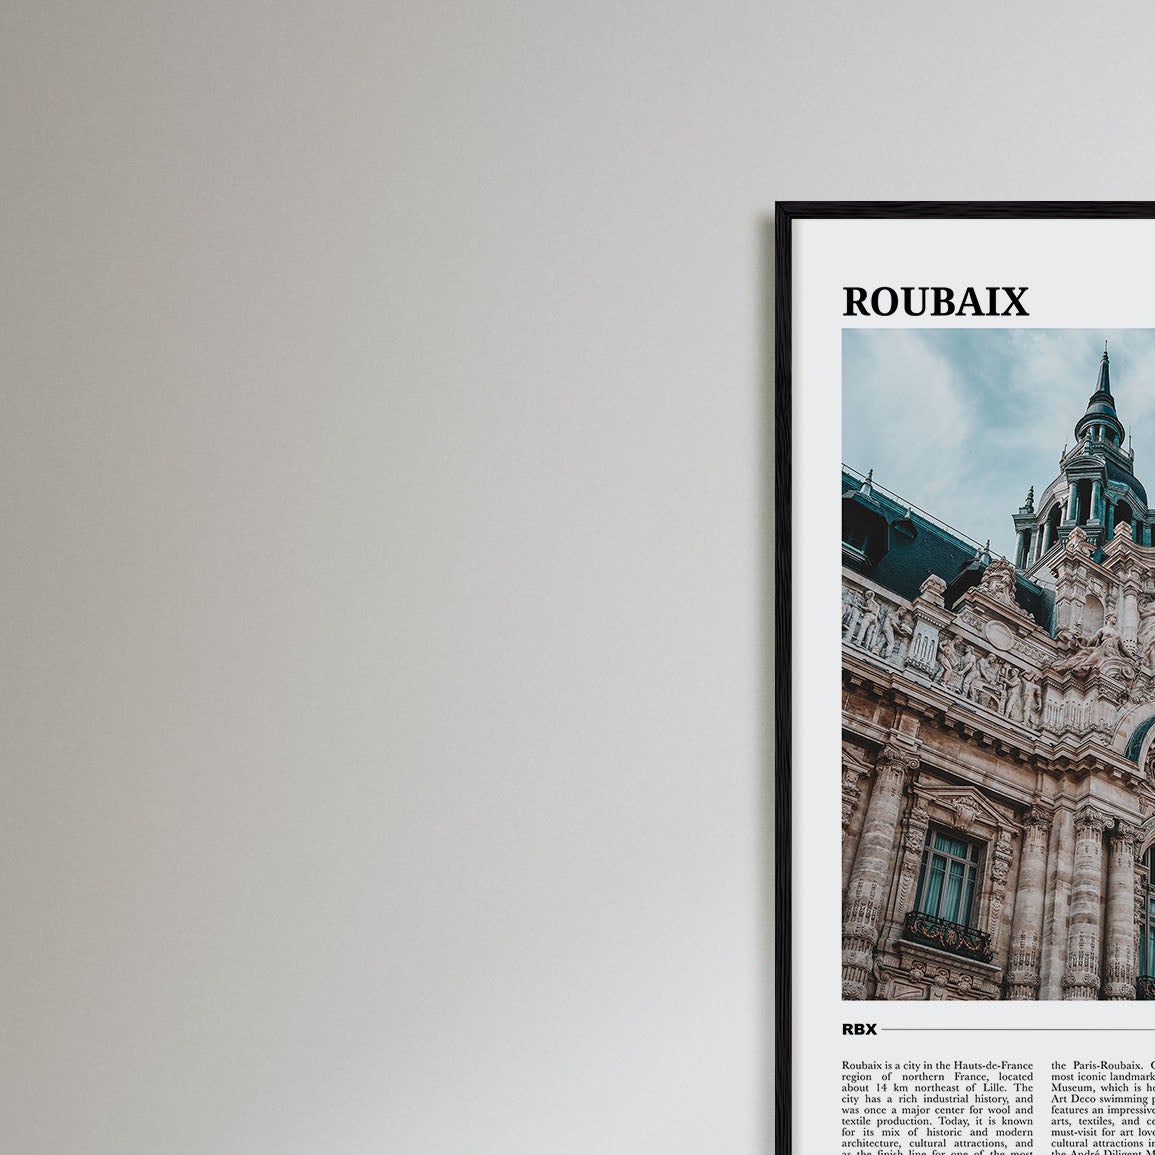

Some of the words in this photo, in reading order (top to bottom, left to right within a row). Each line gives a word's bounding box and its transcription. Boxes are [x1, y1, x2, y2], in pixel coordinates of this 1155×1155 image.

[843, 287, 1030, 316] ROUBAIX
[843, 1023, 877, 1035] RBX
[842, 1061, 882, 1069] Roubaix
[885, 1061, 892, 1069] is
[903, 1061, 920, 1072] city
[923, 1061, 932, 1069] in
[935, 1061, 950, 1069] the
[954, 1061, 1033, 1069] Hauts-de-France
[1051, 1061, 1066, 1069] the
[1073, 1061, 1143, 1069] Paris-Roubaix.
[842, 1072, 871, 1083] region
[881, 1072, 891, 1080] of
[902, 1072, 944, 1080] northern
[954, 1072, 989, 1082] France,
[999, 1072, 1033, 1080] located
[1051, 1072, 1073, 1080] most
[1078, 1072, 1106, 1080] iconic
[841, 1083, 869, 1092] about
[877, 1083, 887, 1092] 14
[893, 1083, 908, 1092] km
[915, 1083, 959, 1092] northeast
[965, 1083, 976, 1092] of
[983, 1083, 1006, 1092] Lille.
[1014, 1083, 1033, 1092] The
[841, 1094, 859, 1105] city
[865, 1094, 881, 1103] has
[899, 1094, 917, 1103] rich
[923, 1094, 968, 1103] industrial
[975, 1094, 1009, 1105] history,
[1015, 1094, 1033, 1103] and
[1051, 1094, 1066, 1103] Art
[1071, 1094, 1096, 1103] Deco
[1099, 1094, 1148, 1105] swimming
[1051, 1105, 1088, 1114] features
[841, 1116, 870, 1125] textile
[876, 1116, 932, 1127] production.
[939, 1116, 969, 1127] Today,
[975, 1116, 982, 1125] it
[988, 1116, 996, 1125] is
[1001, 1116, 1033, 1125] known
[841, 1127, 855, 1136] for
[863, 1127, 874, 1136] its
[882, 1127, 900, 1136] mix
[907, 1127, 918, 1136] of
[926, 1127, 962, 1136] historic
[969, 1127, 988, 1136] and
[996, 1127, 1033, 1136] modern
[1051, 1127, 1097, 1136] must-visit
[1102, 1127, 1115, 1136] for
[1120, 1127, 1133, 1136] art
[841, 1138, 901, 1149] architecture,
[909, 1138, 946, 1147] cultural
[953, 1138, 1007, 1149] attractions,
[1015, 1138, 1033, 1147] and
[1051, 1138, 1087, 1147] cultural
[1092, 1138, 1143, 1147] attractions
